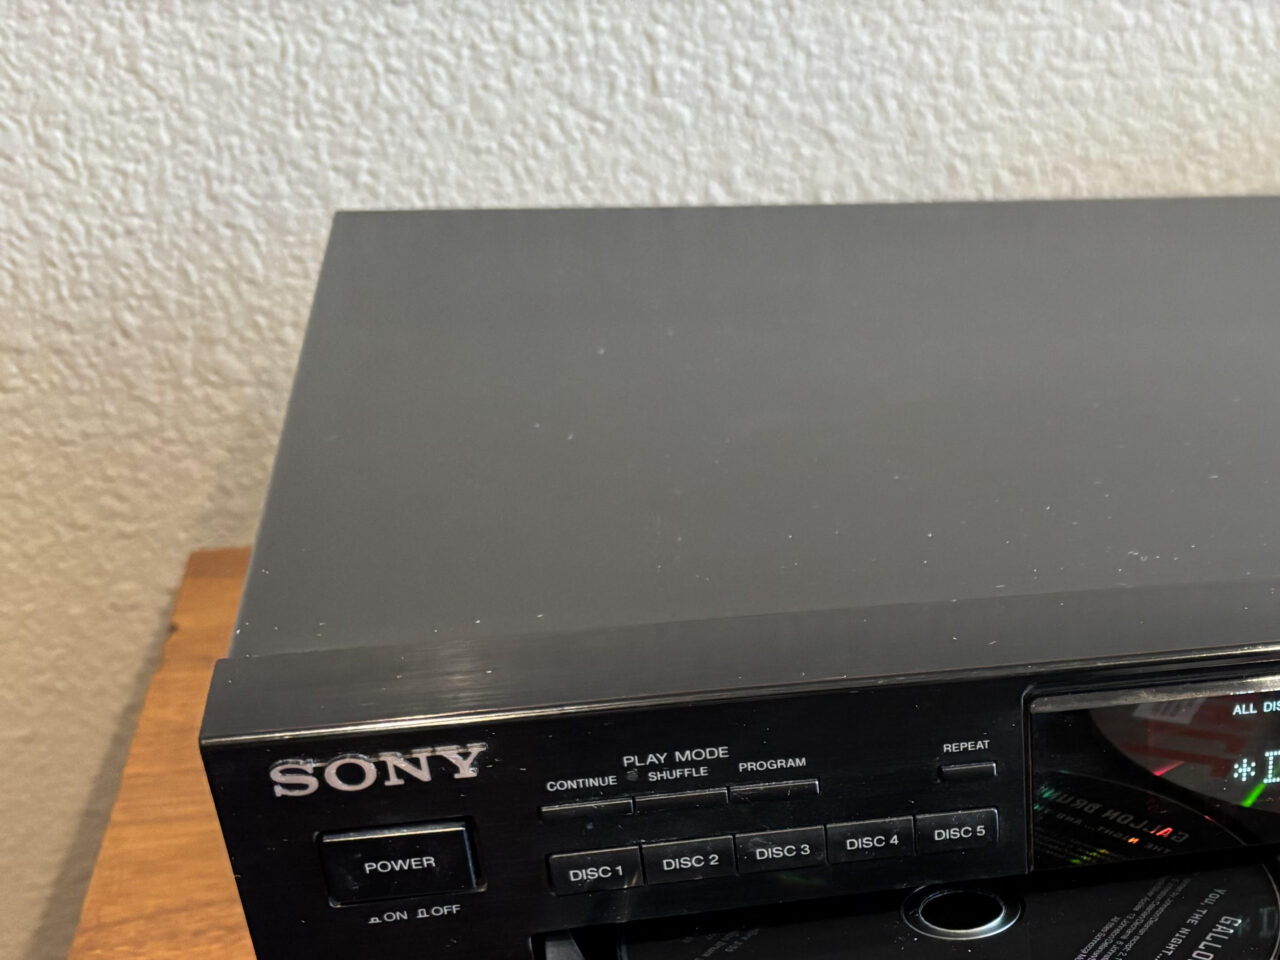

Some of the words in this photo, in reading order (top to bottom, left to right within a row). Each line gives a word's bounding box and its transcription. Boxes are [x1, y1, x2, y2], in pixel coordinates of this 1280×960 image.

[1233, 704, 1257, 716] ALL
[943, 740, 990, 753] REPEAT
[622, 752, 667, 767] PLAY
[675, 746, 729, 763] MODE
[269, 742, 487, 798] SONY
[739, 758, 806, 772] PROGRAM
[648, 767, 708, 782] SHUFFLE
[546, 776, 617, 792] CONTINUE
[934, 828, 972, 841] DISC
[976, 825, 986, 837] 5
[846, 836, 884, 850] DISC
[887, 834, 899, 847] 4
[756, 846, 794, 860] DISC
[800, 844, 811, 856] 3
[364, 856, 436, 874] POWER
[662, 856, 703, 871] DISC
[708, 854, 720, 867] 2
[570, 867, 612, 882] DISC
[617, 865, 624, 877] 1
[1200, 888, 1227, 907] YOU,
[383, 909, 407, 922] ON
[431, 905, 461, 916] OFF
[1186, 908, 1207, 926] THE
